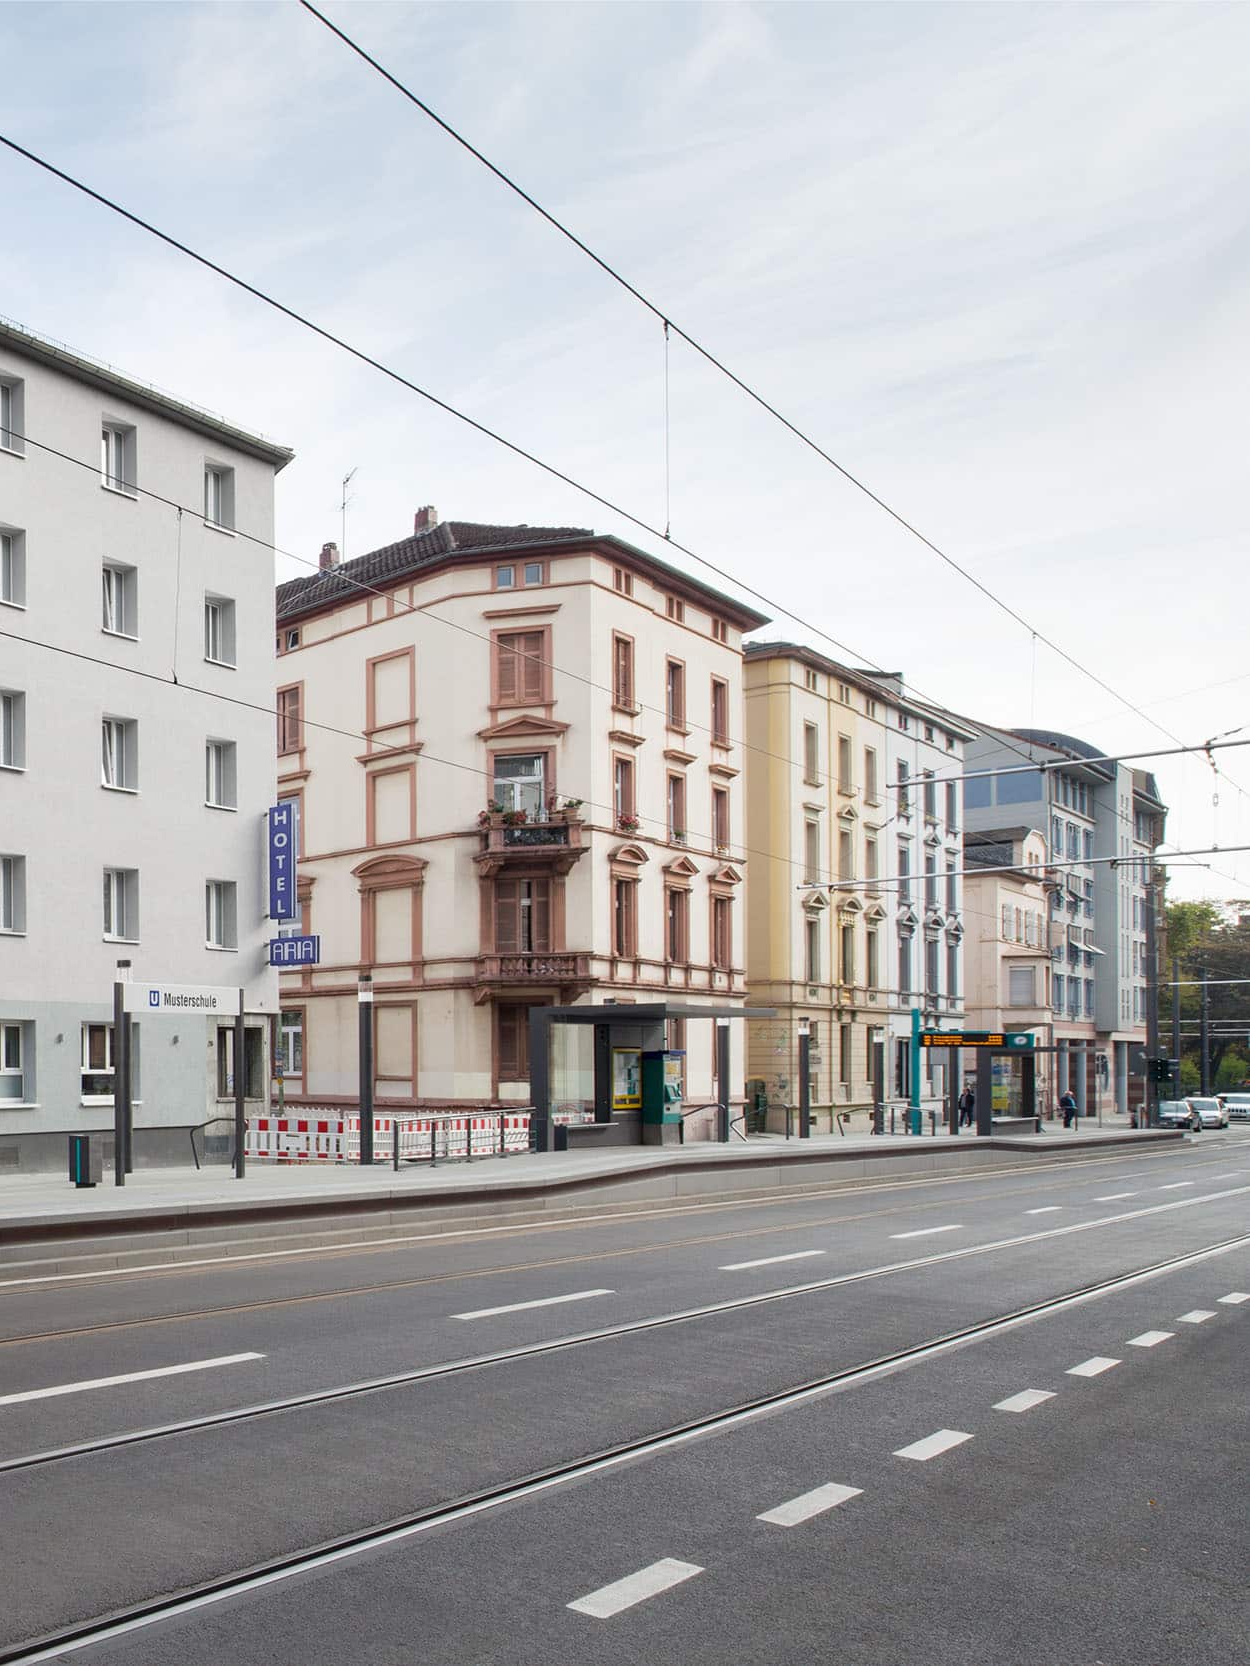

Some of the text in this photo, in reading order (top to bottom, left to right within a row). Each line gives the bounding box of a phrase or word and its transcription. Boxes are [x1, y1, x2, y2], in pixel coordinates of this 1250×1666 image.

[273, 810, 288, 914] HOTEL
[272, 940, 314, 961] ARIA
[150, 991, 217, 1008] U Musterschule
